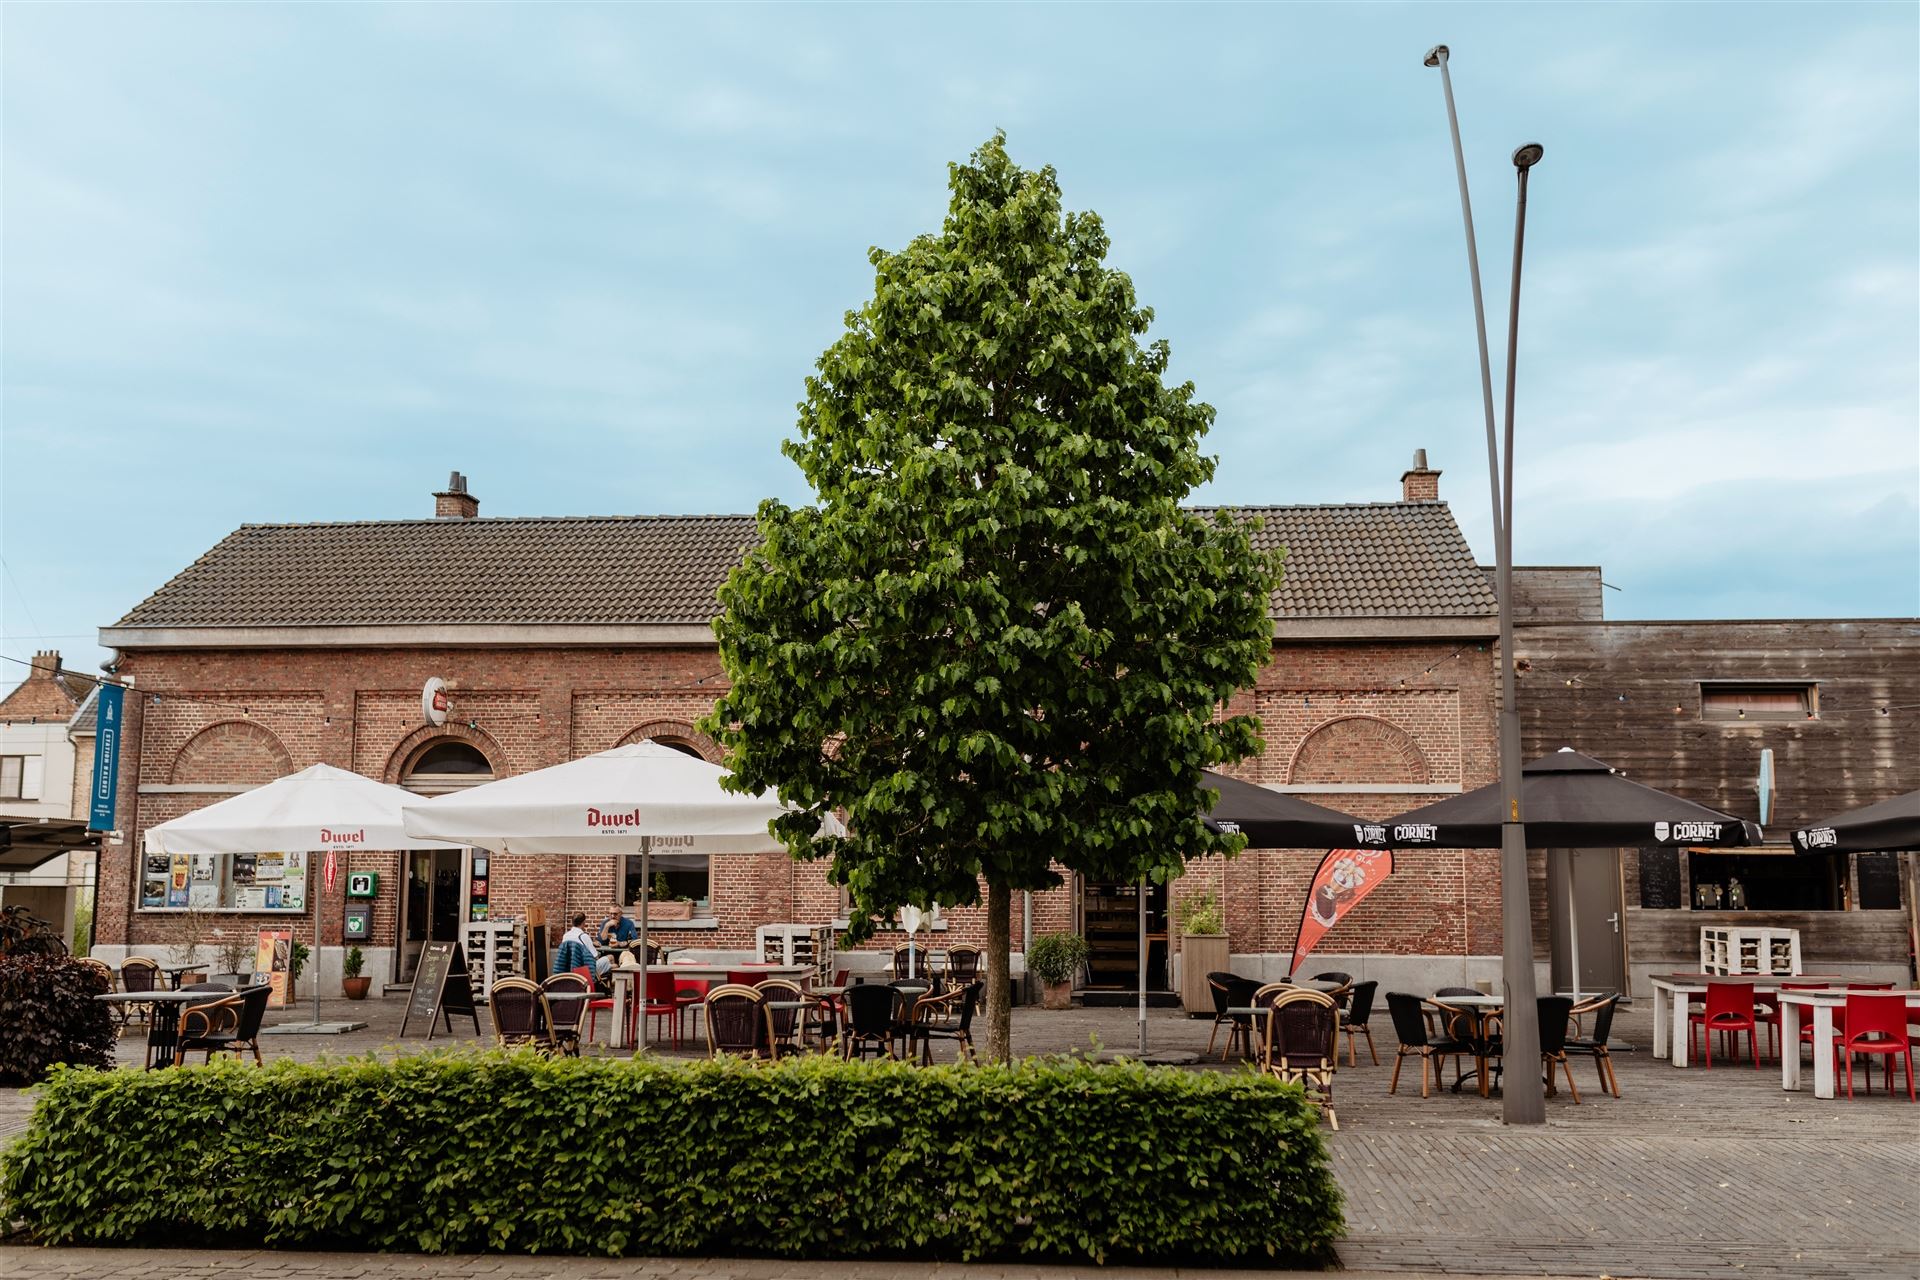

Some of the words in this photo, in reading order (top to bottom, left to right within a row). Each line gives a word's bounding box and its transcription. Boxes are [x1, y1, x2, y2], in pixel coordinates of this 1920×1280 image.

[587, 808, 640, 827] Duvel
[321, 828, 365, 843] Duvel
[1364, 827, 1386, 843] CORNET
[1394, 826, 1438, 841] CORNET
[1673, 824, 1722, 840] CORNET
[1808, 829, 1837, 847] CORNET
[1356, 855, 1373, 866] OLA
